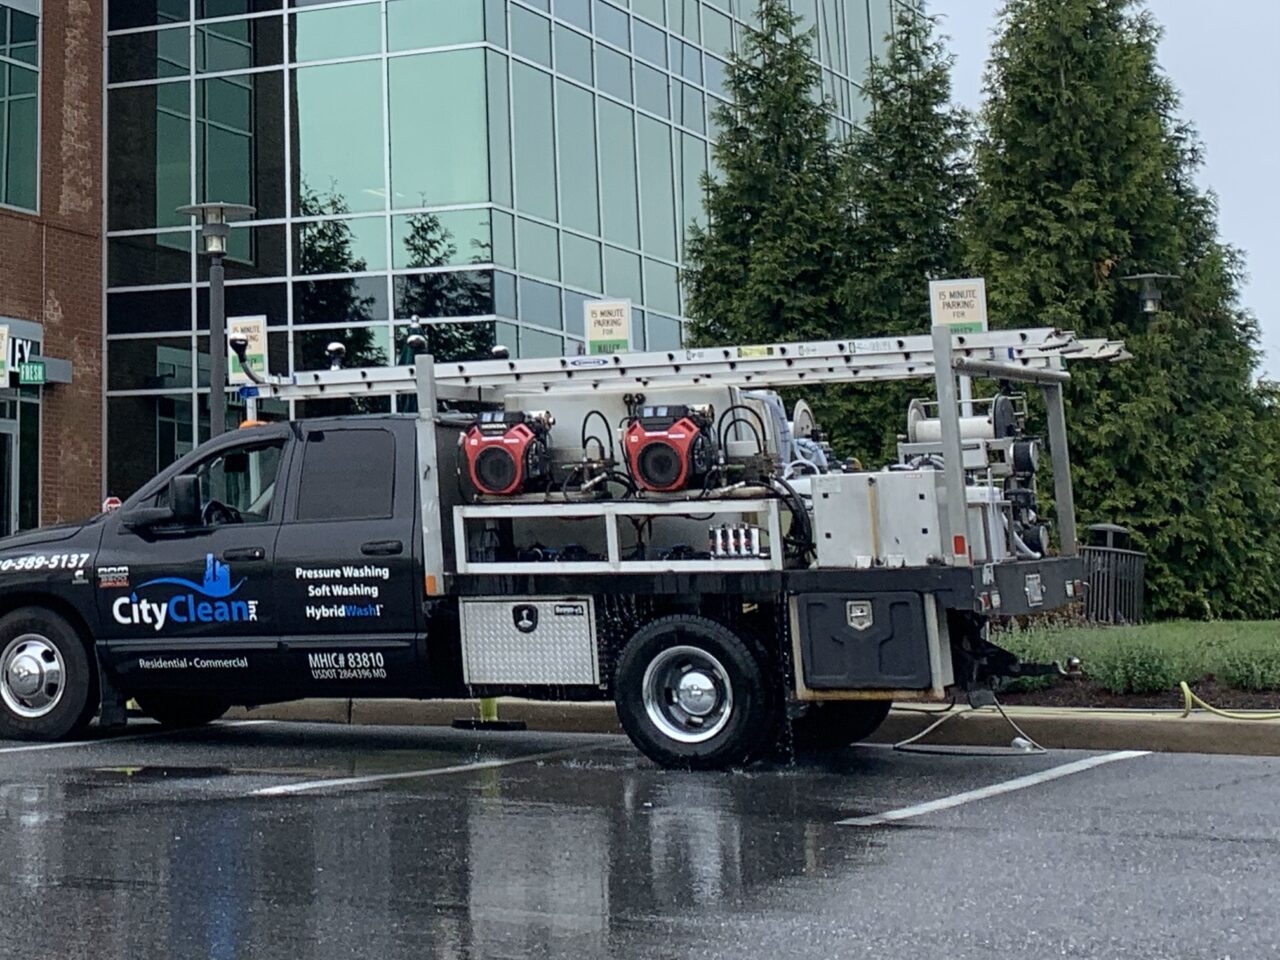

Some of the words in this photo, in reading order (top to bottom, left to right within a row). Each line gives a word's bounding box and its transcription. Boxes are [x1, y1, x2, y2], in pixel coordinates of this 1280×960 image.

[938, 291, 946, 300] 15
[949, 289, 977, 299] MINUTE
[942, 300, 974, 310] PARKING
[591, 310, 598, 318] 15
[600, 308, 624, 318] MINUTE
[241, 325, 260, 333] MINUTE
[593, 319, 622, 328] PARKING
[602, 328, 613, 336] FOR
[8, 337, 32, 372] LEY
[21, 364, 44, 381] FRESH
[295, 567, 341, 579] Pressure
[342, 565, 390, 580] Washing
[308, 584, 331, 597] Soft
[332, 583, 379, 598] Washing
[112, 592, 248, 632] CityClean
[248, 600, 259, 622] inc
[139, 658, 188, 669] Residential
[193, 657, 249, 669] Commercial
[308, 652, 345, 668] MHIC#
[347, 652, 385, 668] 83810
[311, 669, 337, 680] USDOT
[372, 668, 387, 678] MD
